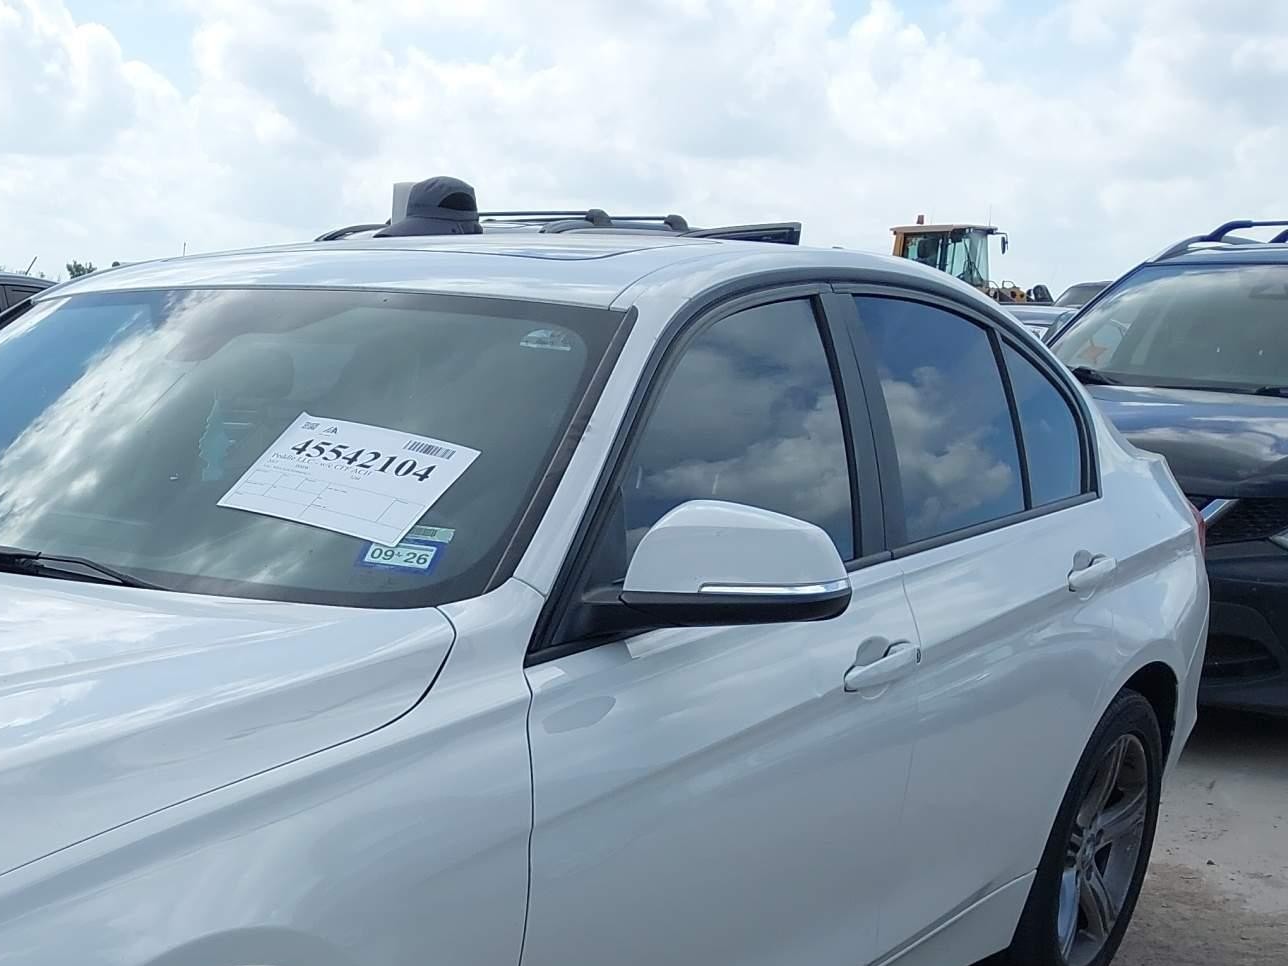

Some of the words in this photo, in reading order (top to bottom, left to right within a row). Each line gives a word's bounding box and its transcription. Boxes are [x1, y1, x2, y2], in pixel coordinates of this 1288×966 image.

[291, 439, 437, 482] 45542104
[370, 547, 395, 561] 09
[403, 551, 430, 565] 26
